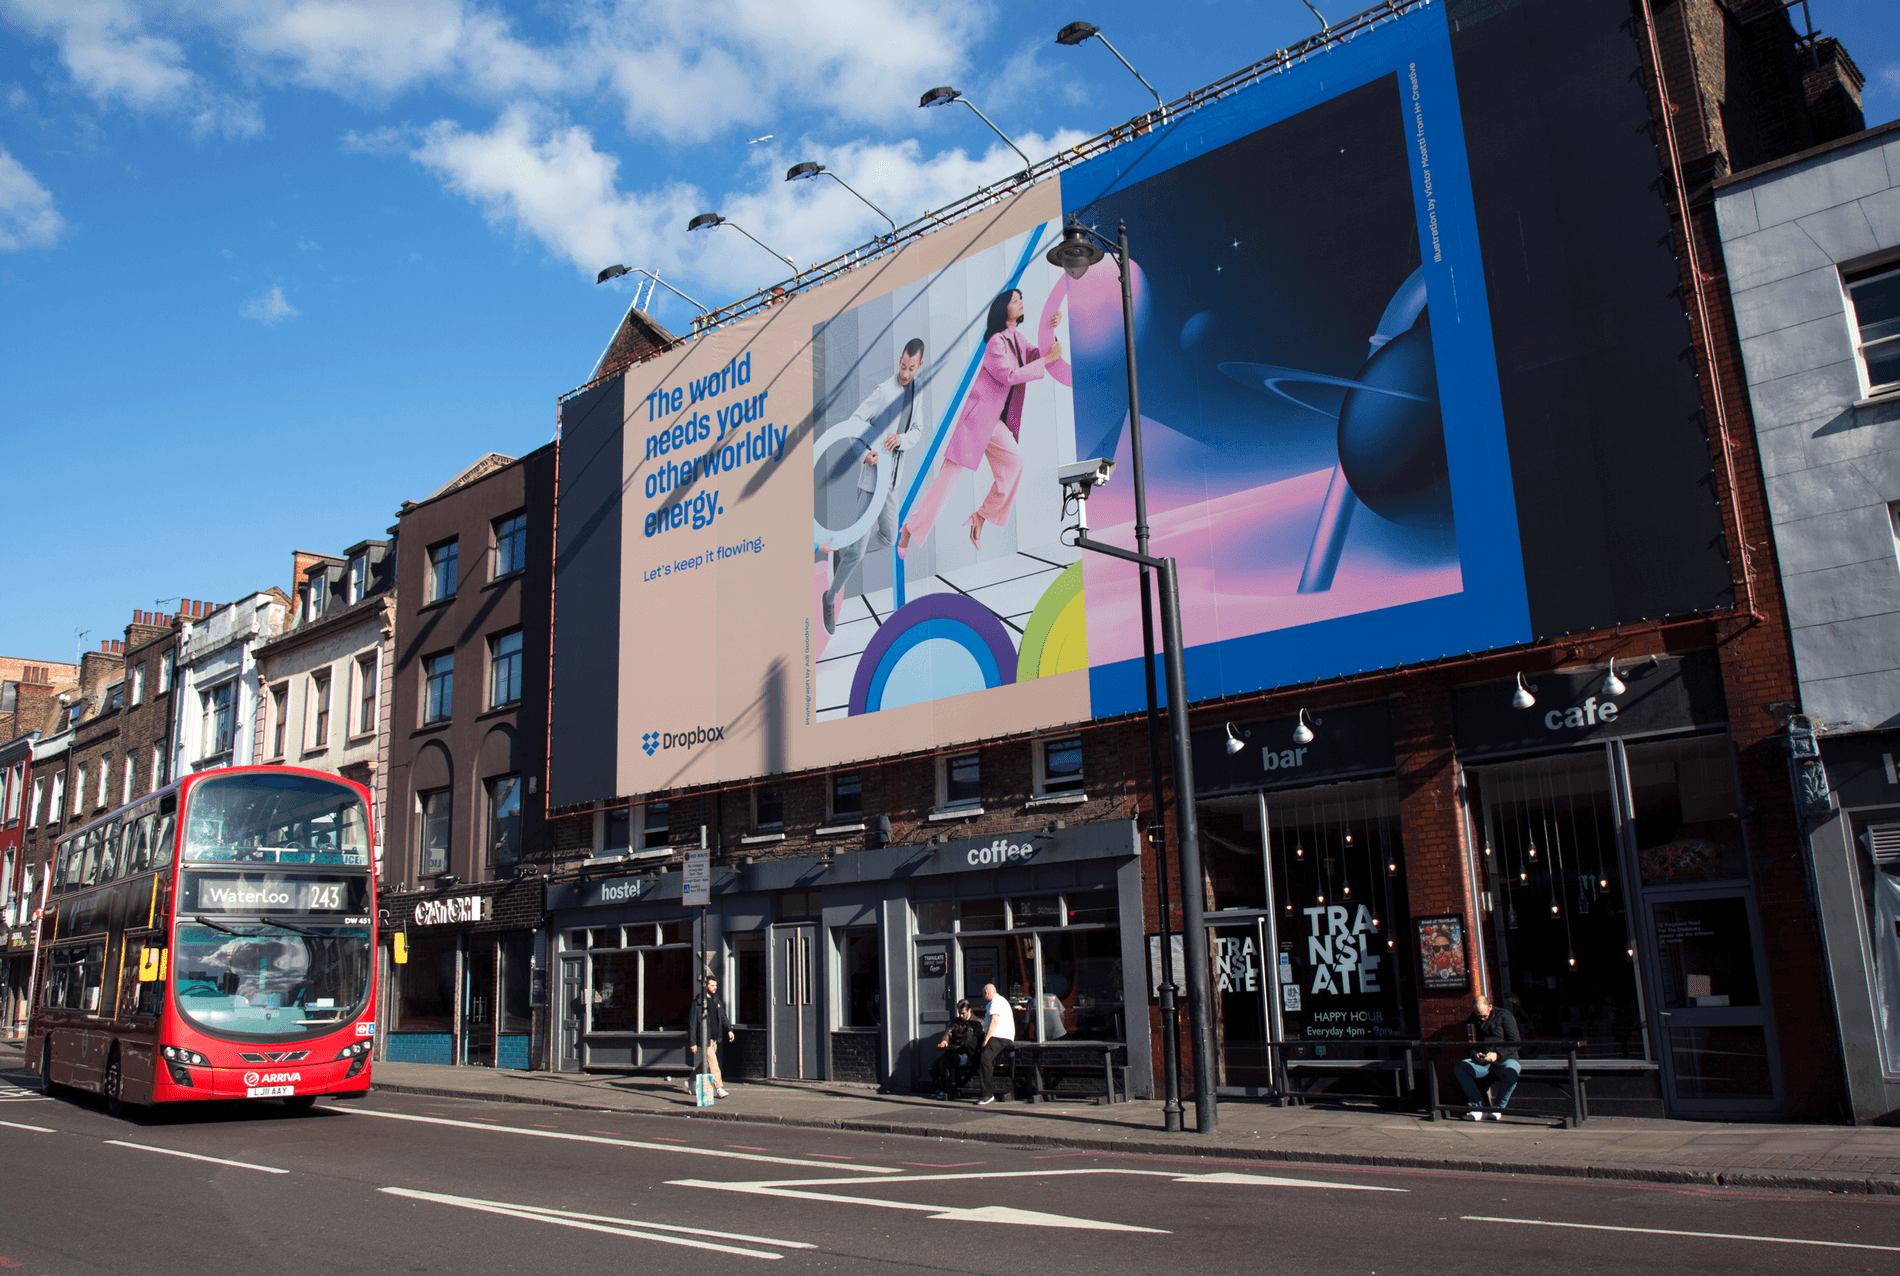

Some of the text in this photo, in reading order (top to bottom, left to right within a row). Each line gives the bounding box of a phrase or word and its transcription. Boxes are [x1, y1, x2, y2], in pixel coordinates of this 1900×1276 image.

[1408, 62, 1420, 101] Creative
[1416, 113, 1425, 137] from
[1417, 137, 1429, 168] Moatti
[1423, 169, 1433, 198] Victor
[1427, 198, 1436, 211] by
[1429, 211, 1442, 263] Illustration
[646, 351, 751, 422] The world
[646, 390, 768, 461] needs your
[645, 423, 788, 499] otherworldly
[644, 489, 724, 538] energy.
[643, 536, 765, 582] Let's keep it flowing.
[804, 668, 811, 680] by
[1544, 696, 1619, 731] cafe
[662, 726, 724, 750] Dropbox
[1262, 745, 1307, 771] bar
[967, 839, 1033, 866] coffee
[210, 887, 289, 904] Waterloo
[310, 886, 339, 908] 243
[601, 879, 641, 901] hostel
[344, 917, 358, 925] DW
[1303, 904, 1379, 938] TRA
[1213, 937, 1258, 957] TRA
[1217, 972, 1258, 993] ATE
[1311, 963, 1381, 995] ATE
[1314, 1011, 1384, 1022] HAPPY HOUR
[1306, 1026, 1343, 1038] Everyday
[1346, 1026, 1365, 1036] 4pm
[1373, 1025, 1394, 1037] 9pm
[261, 1072, 301, 1083] ARRIVA
[254, 1086, 287, 1096] LJ11 AAY
